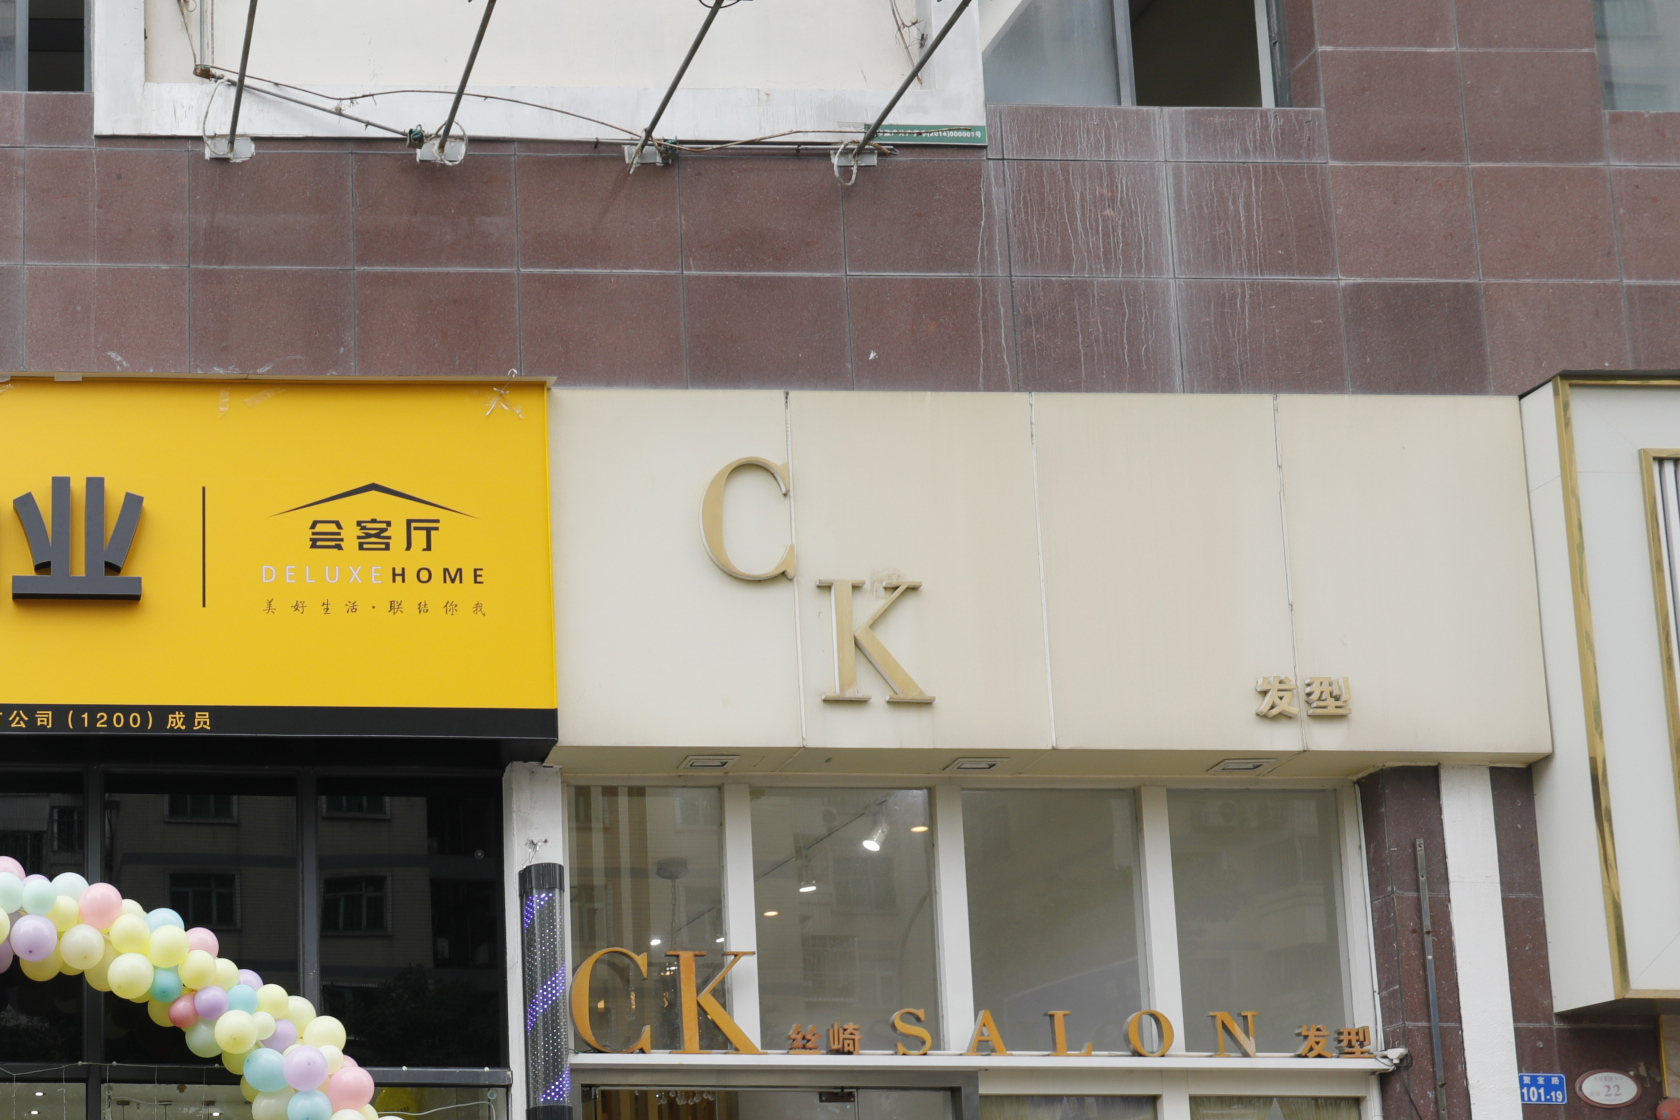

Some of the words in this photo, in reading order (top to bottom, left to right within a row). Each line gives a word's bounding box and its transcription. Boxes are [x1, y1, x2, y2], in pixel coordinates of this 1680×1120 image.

[309, 518, 441, 552] 会客厅
[1255, 676, 1351, 718] 发型
[570, 947, 766, 1056] CK
[892, 1008, 1260, 1057] SALON
[1296, 1026, 1375, 1058] 发型
[1522, 1076, 1560, 1085] 聚宝路
[1604, 1084, 1622, 1097] 22
[1521, 1087, 1563, 1102] 101-19
